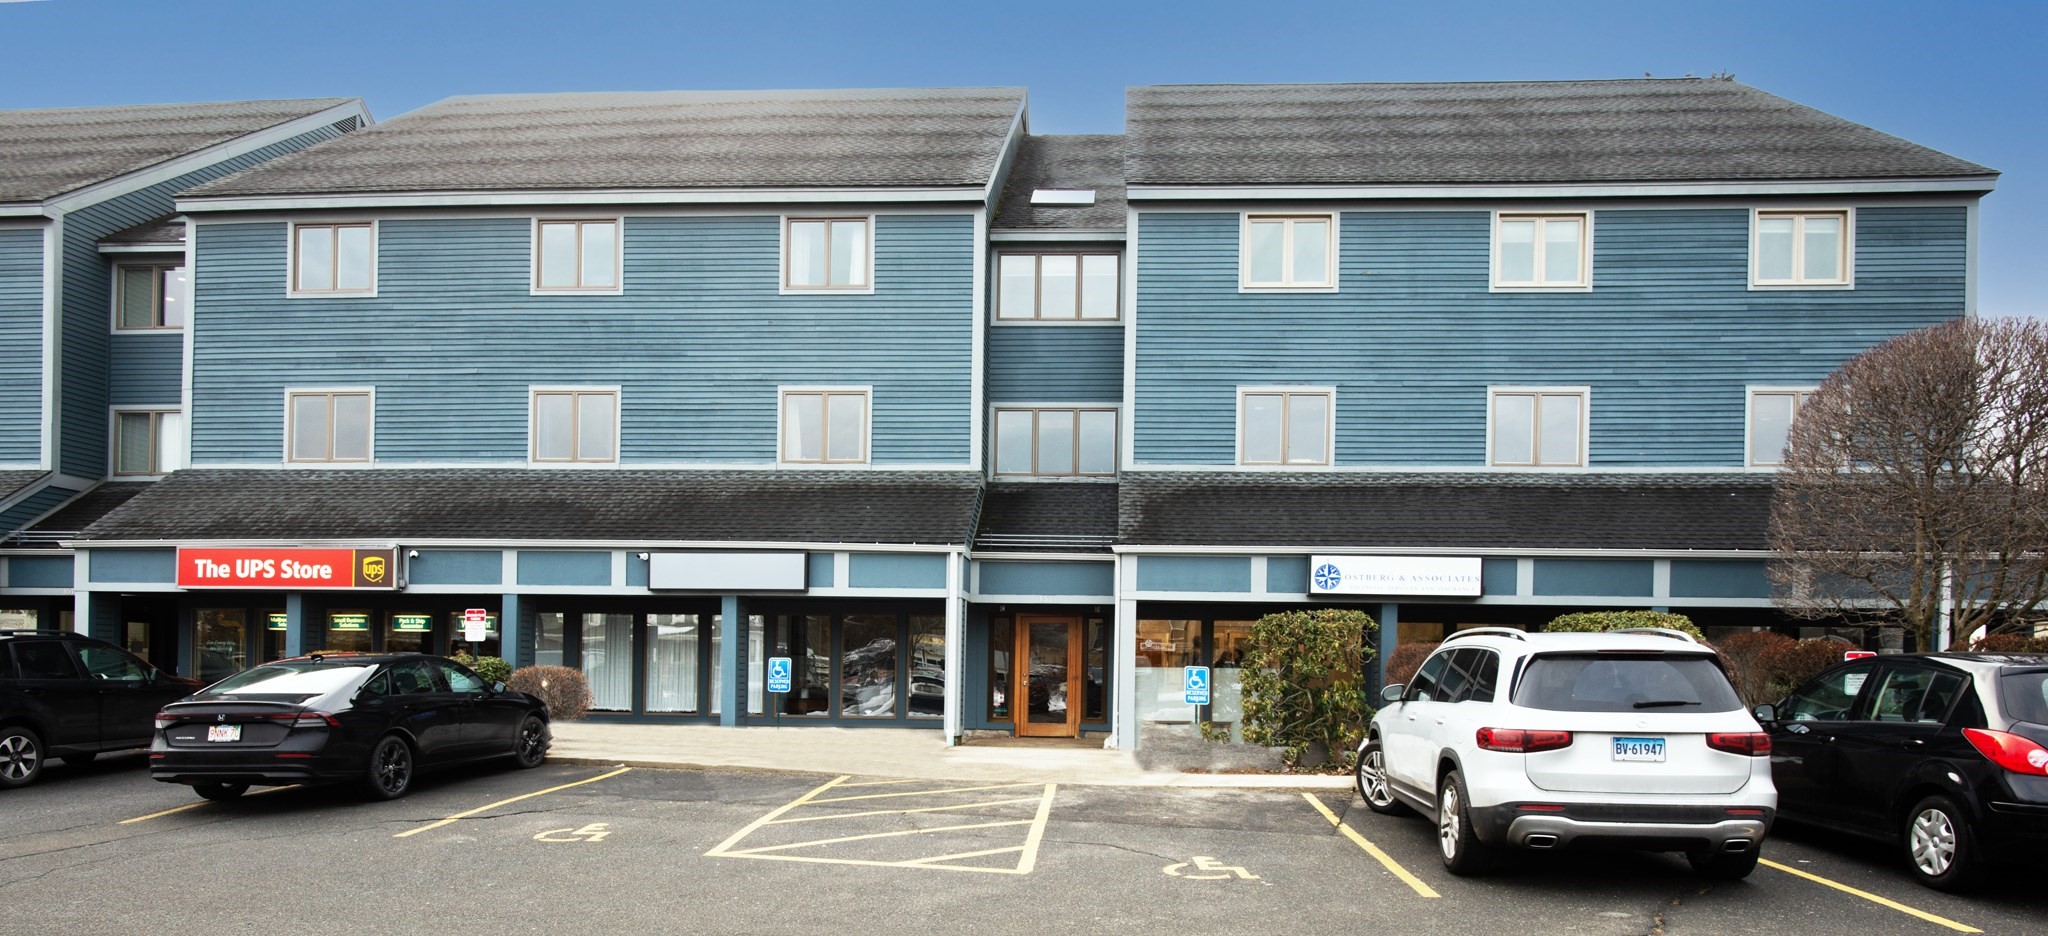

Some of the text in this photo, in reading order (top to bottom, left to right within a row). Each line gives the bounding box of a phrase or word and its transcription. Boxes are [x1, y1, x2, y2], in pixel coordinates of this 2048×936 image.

[194, 558, 332, 579] The UPS Store
[365, 563, 384, 578] ups
[1344, 574, 1394, 582] OSTBERG
[1411, 575, 1480, 583] ASSOCIATES
